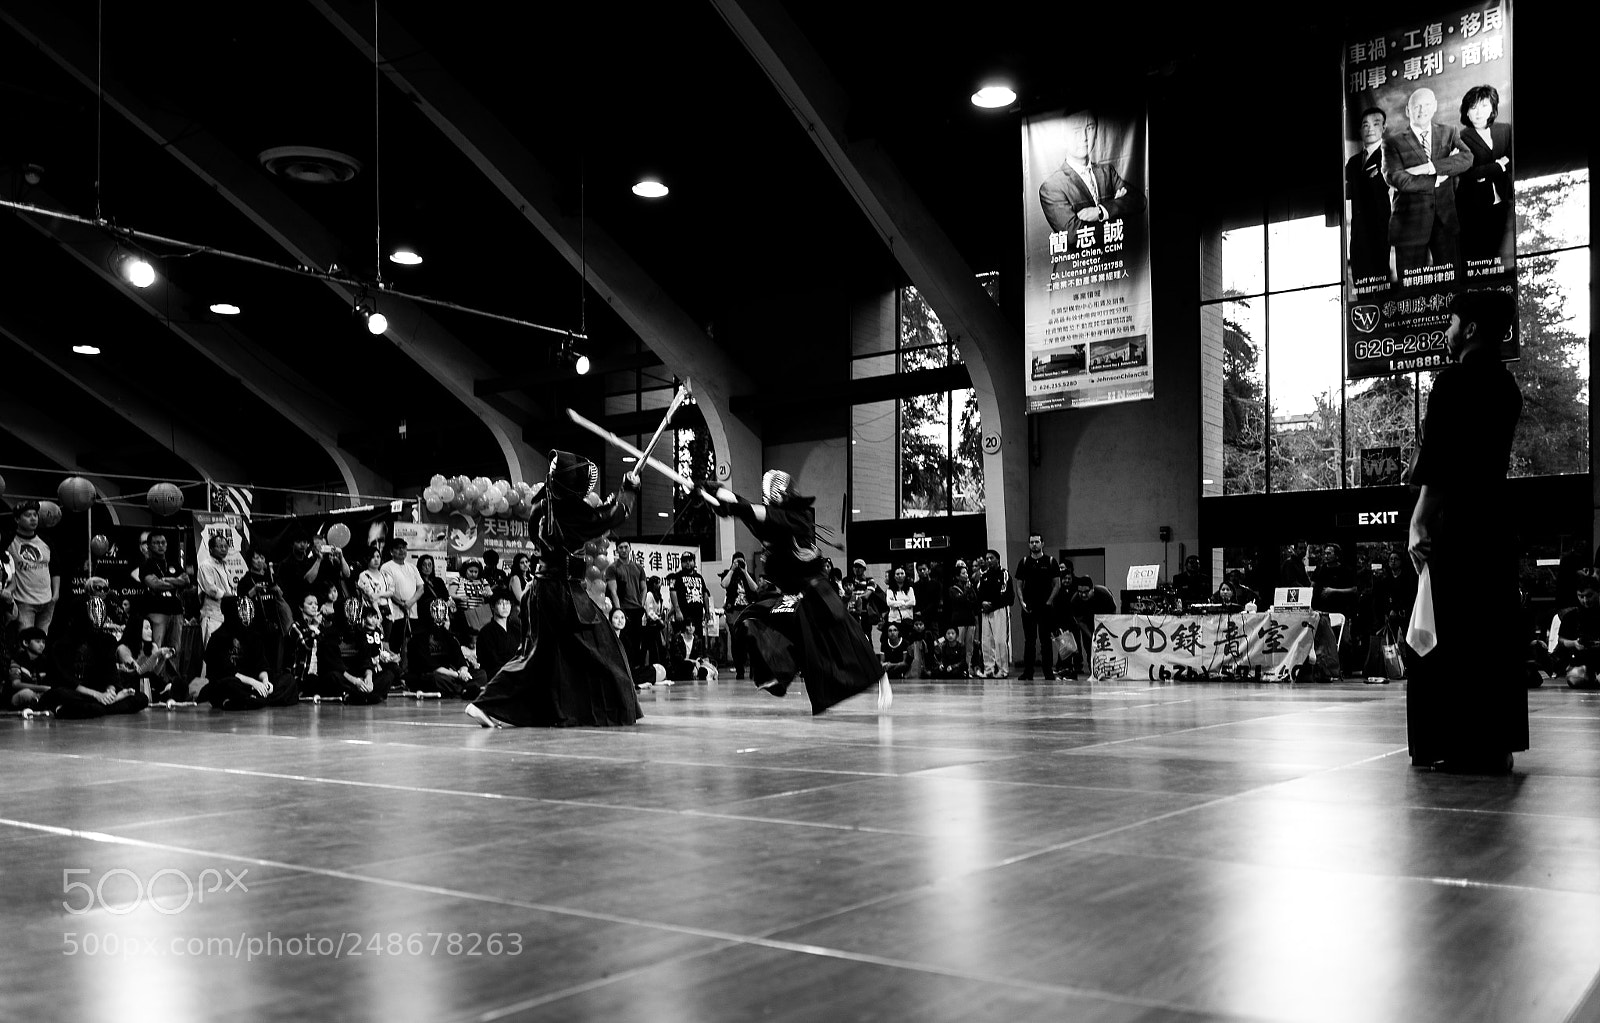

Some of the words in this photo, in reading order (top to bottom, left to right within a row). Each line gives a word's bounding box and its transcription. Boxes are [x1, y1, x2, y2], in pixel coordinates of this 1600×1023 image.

[1049, 218, 1124, 255] 簡志誠
[1050, 252, 1080, 264] Johnson
[1104, 242, 1123, 253] CCIM
[1072, 257, 1101, 268] Director
[1404, 267, 1422, 275] Scott
[1423, 262, 1454, 273] Warmuth
[1050, 272, 1060, 280] CA
[1061, 268, 1087, 278] License
[1403, 270, 1455, 287] 華明勝律師
[1355, 277, 1368, 285] Jeff
[1412, 315, 1440, 324] OFFICES
[985, 436, 998, 448] 20
[719, 465, 727, 475] 21
[1358, 511, 1399, 525] EXIT
[904, 537, 932, 549] EXIT
[1093, 619, 1290, 658] 金CD錄音室
